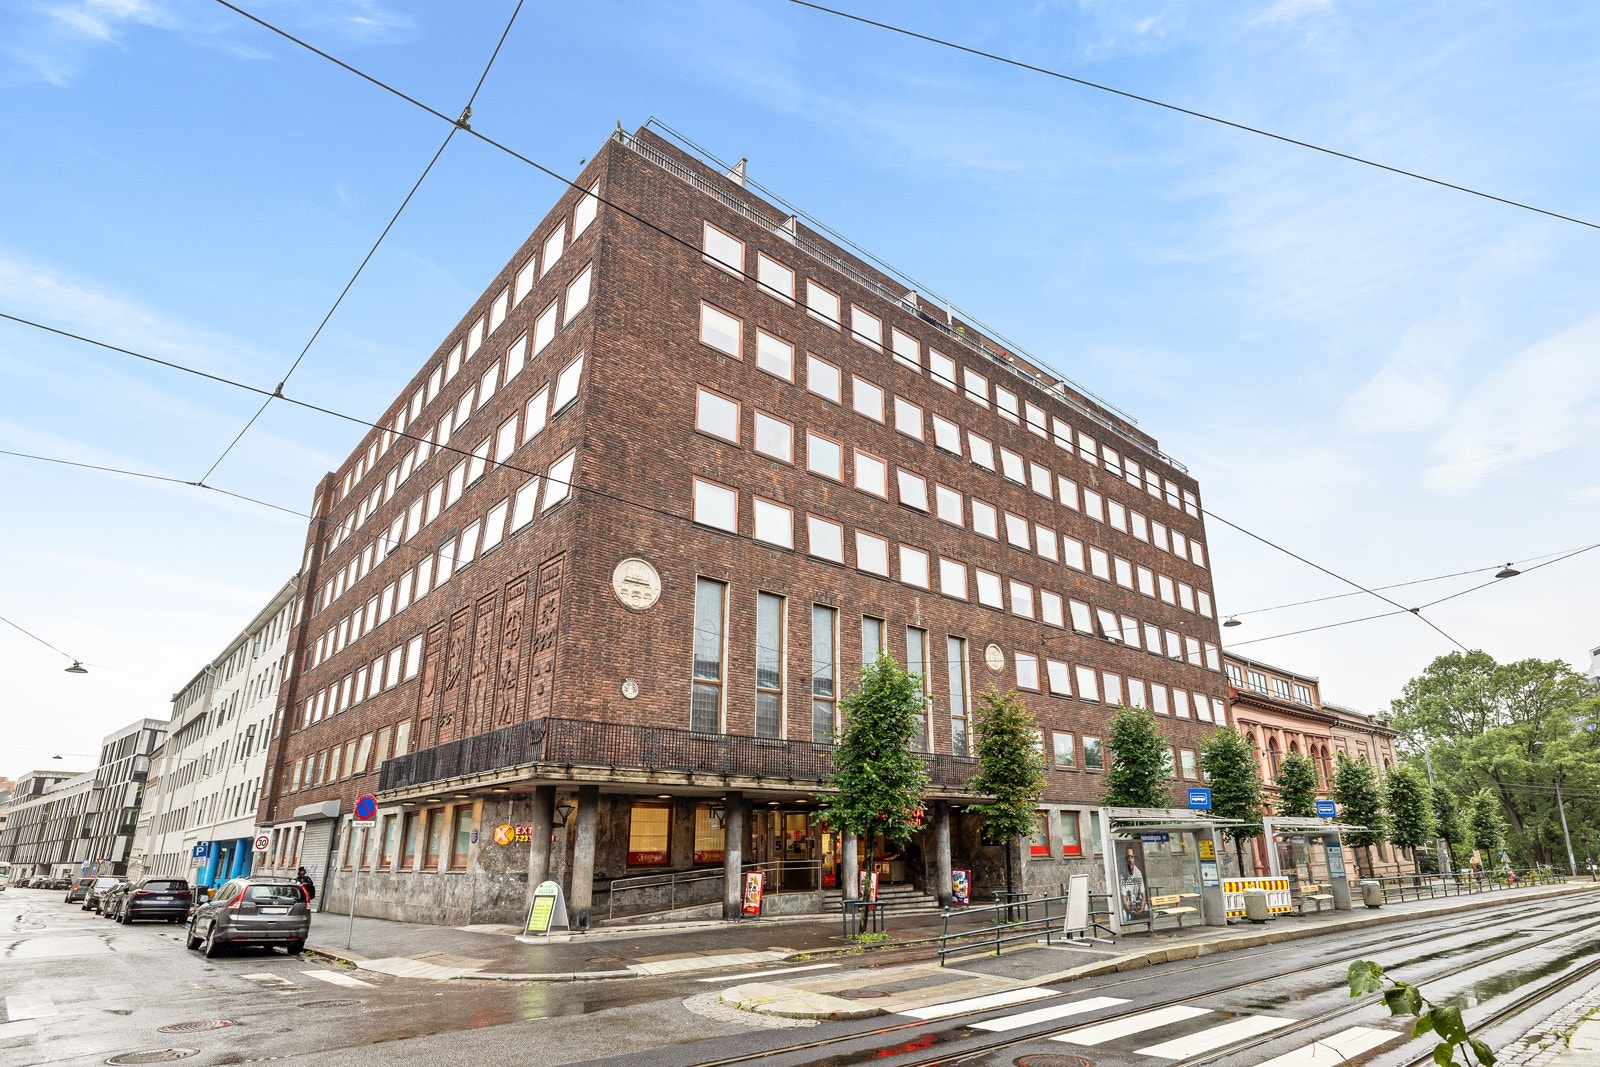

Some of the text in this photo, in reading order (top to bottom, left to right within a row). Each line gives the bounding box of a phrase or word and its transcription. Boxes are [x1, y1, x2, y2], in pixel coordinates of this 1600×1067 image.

[257, 839, 267, 847] 30
[775, 840, 782, 851] 5
[196, 847, 204, 856] P
